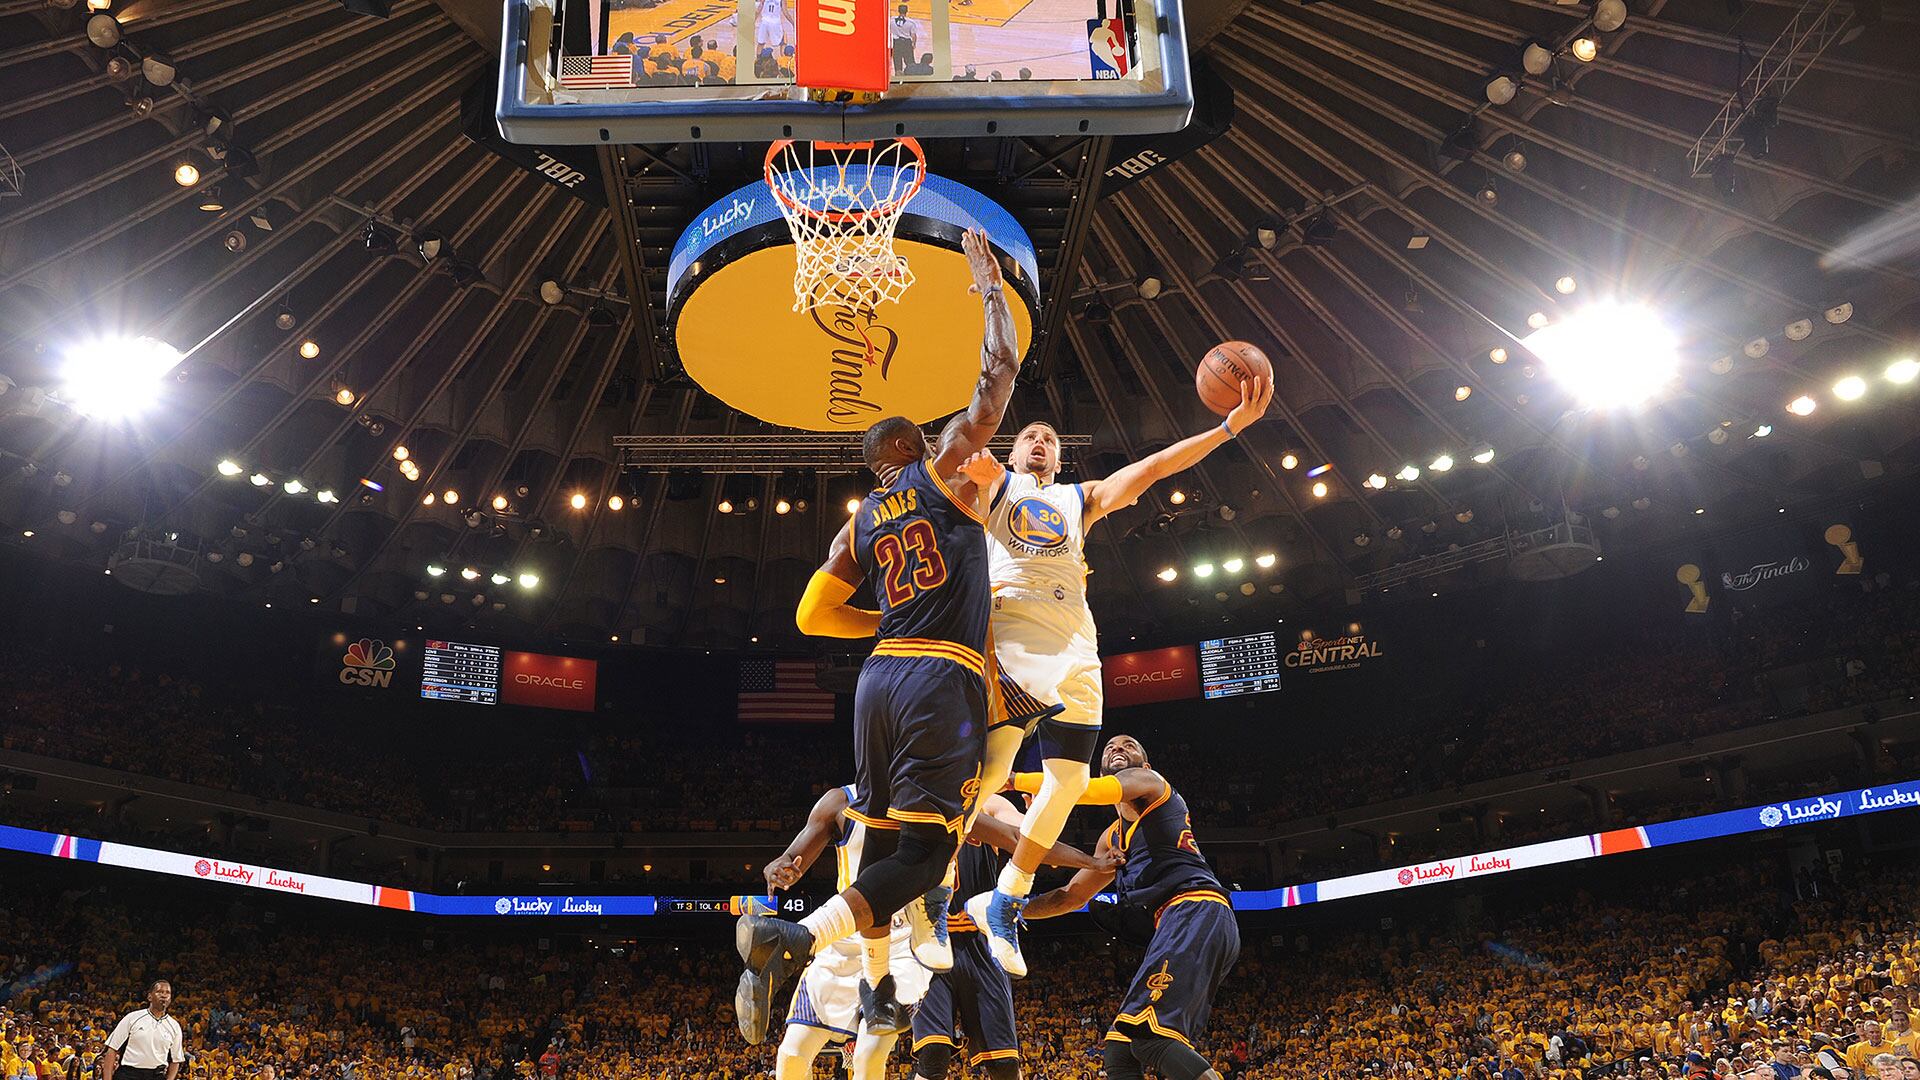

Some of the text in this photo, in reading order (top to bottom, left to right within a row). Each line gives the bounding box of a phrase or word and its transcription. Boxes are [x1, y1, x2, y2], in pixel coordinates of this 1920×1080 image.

[633, 4, 731, 45] OLDEN
[818, 0, 856, 35] m
[1095, 69, 1118, 80] NBA
[535, 153, 586, 188] JBL
[1105, 150, 1167, 179] JBL
[702, 198, 755, 237] Lucky
[872, 488, 917, 527] JAMES
[1039, 509, 1061, 526] 30
[1008, 537, 1070, 558] WARRIORS
[874, 519, 947, 608] 23
[1734, 557, 1809, 590] The Finals
[1284, 641, 1383, 667] CENTRAL
[339, 667, 393, 688] CSN
[515, 673, 584, 689] ORACLE
[1113, 668, 1183, 686] ORACLE
[1782, 789, 1920, 820] Lucky Lucky
[213, 861, 305, 892] Lucky Lucky
[1414, 856, 1511, 879] Lucky Lucky
[512, 896, 602, 915] Lucky Lucky
[686, 902, 693, 911] 3
[714, 902, 721, 911] 4
[722, 903, 729, 911] 0
[783, 899, 804, 912] 48
